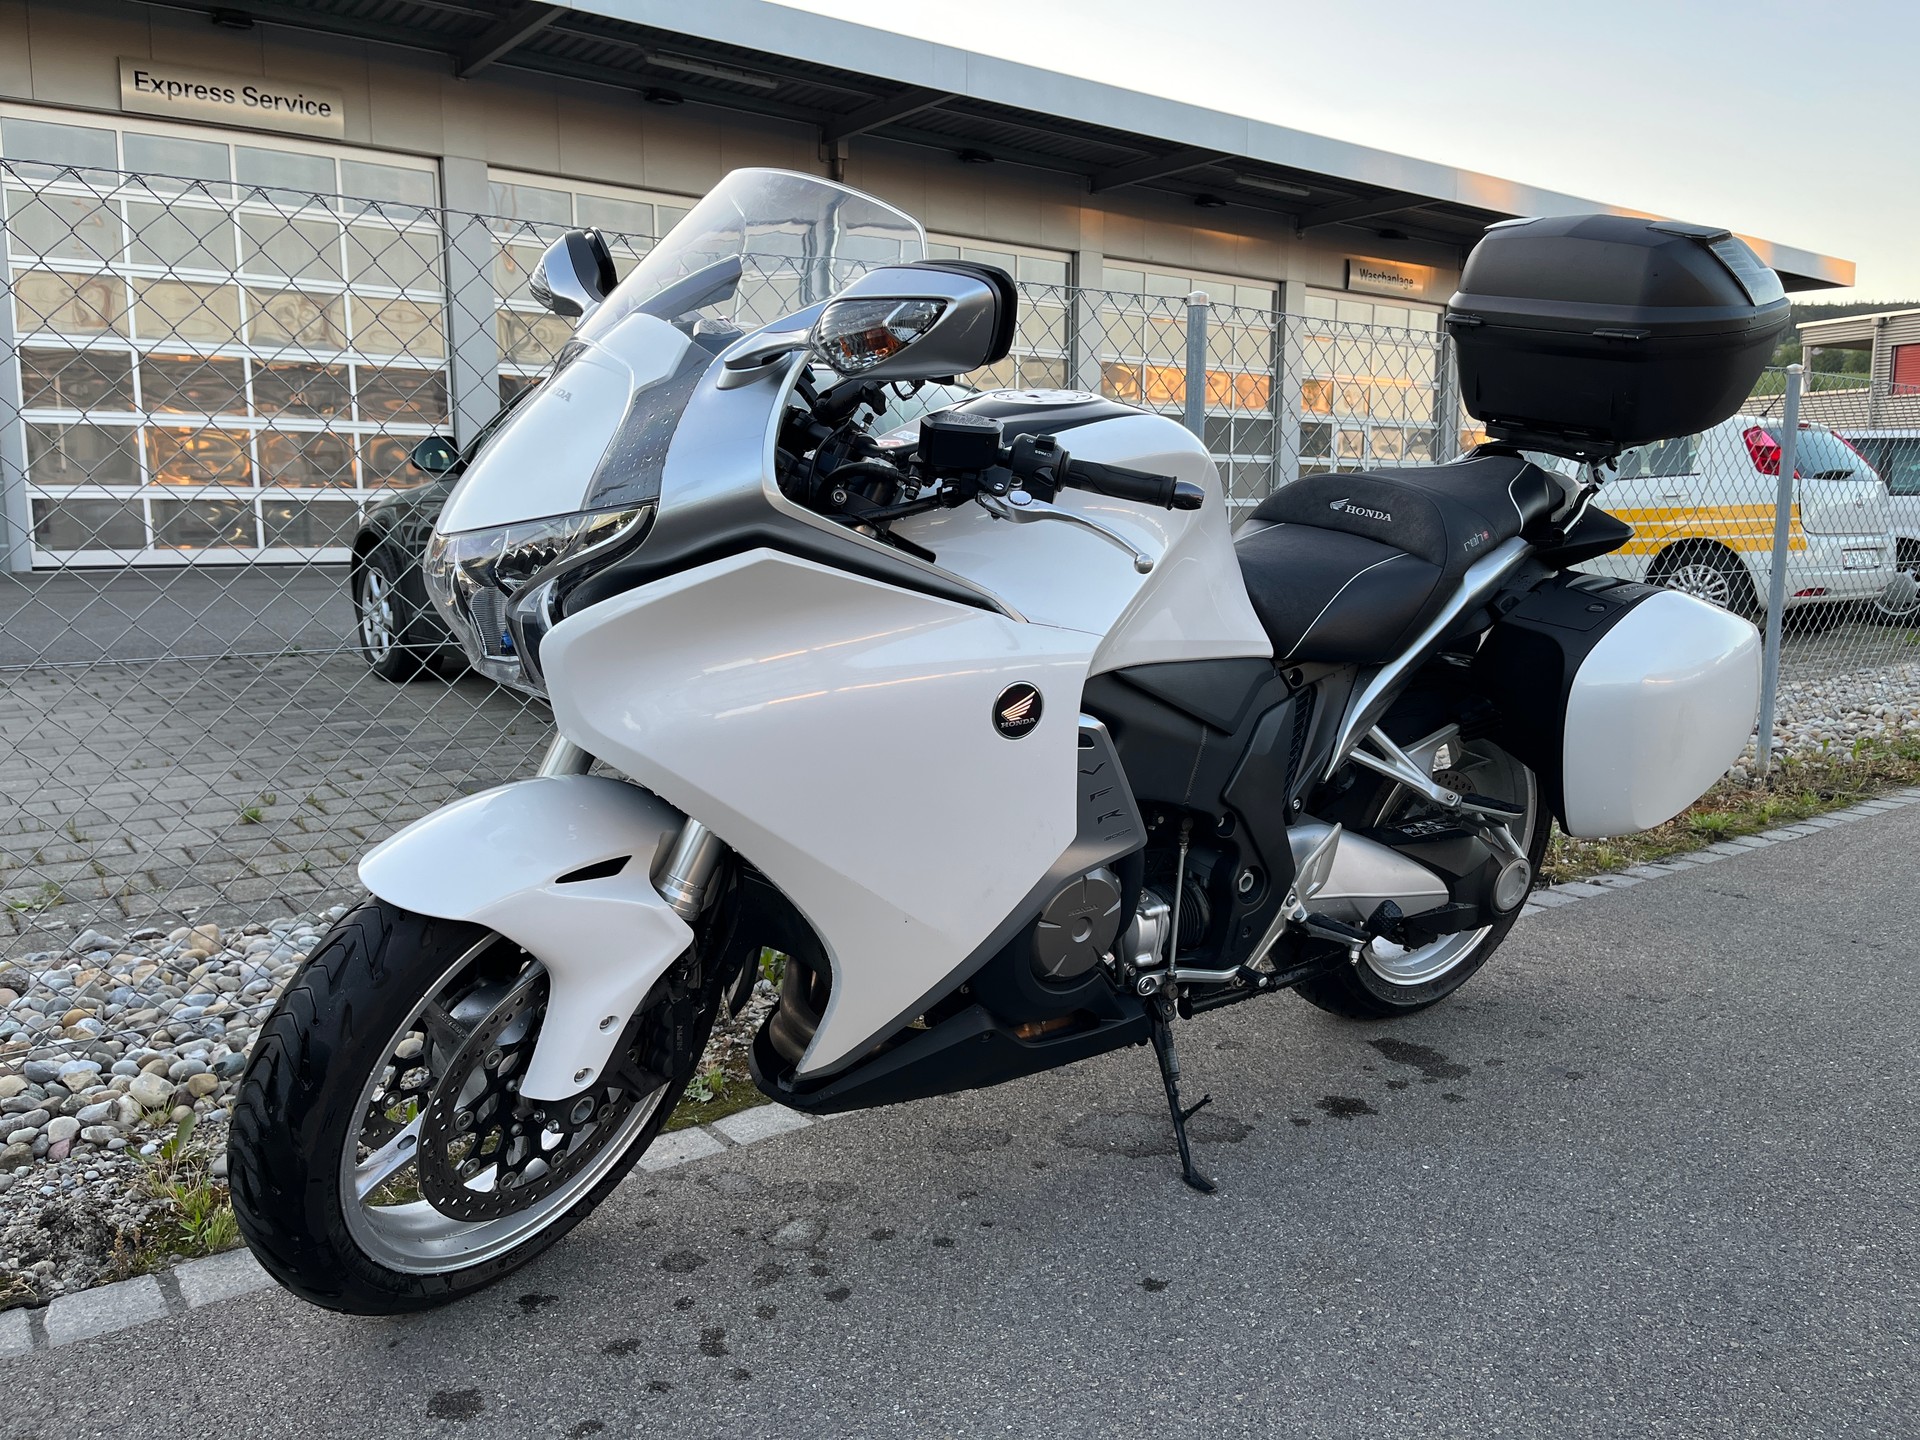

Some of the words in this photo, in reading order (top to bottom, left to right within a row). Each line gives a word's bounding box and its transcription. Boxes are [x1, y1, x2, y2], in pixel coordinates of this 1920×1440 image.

[134, 70, 235, 104] Express
[242, 86, 331, 118] Service
[1359, 268, 1414, 290] Waschanlage
[1344, 504, 1392, 522] HONDA
[1000, 717, 1036, 728] HONDA
